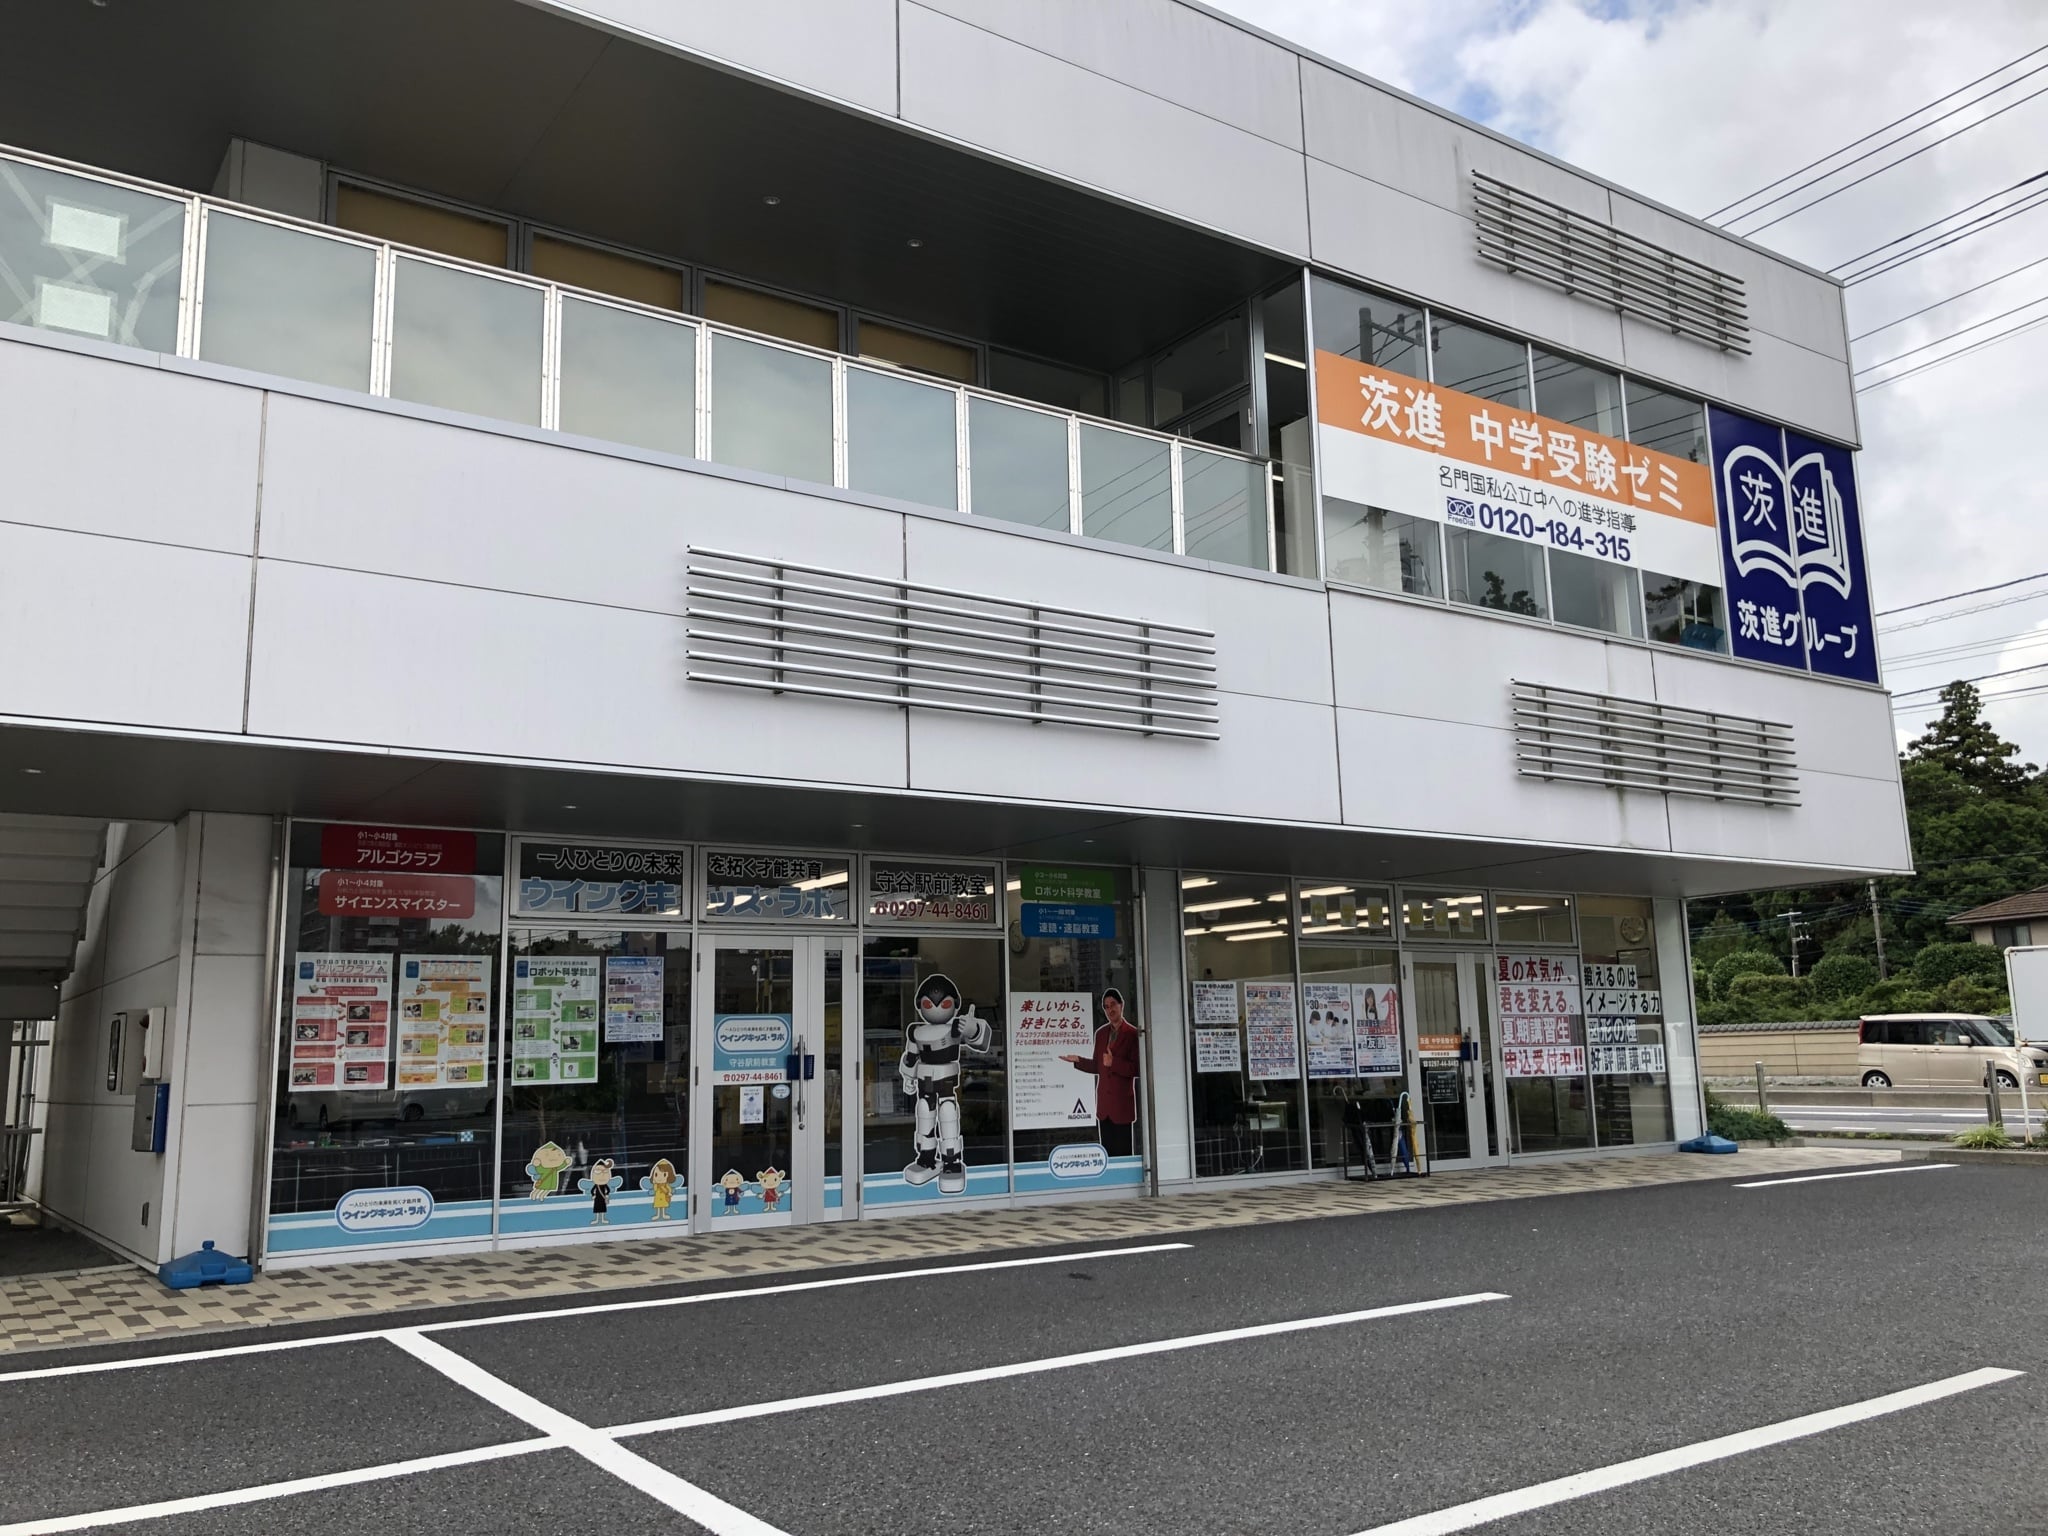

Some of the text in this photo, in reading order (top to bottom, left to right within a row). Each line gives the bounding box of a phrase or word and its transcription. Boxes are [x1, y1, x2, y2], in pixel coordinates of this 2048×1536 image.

[1359, 375, 1683, 512] 茨進 中学受験ゼミ
[1439, 465, 1637, 534] 名門国私公立中への進学指導
[1479, 502, 1632, 563] 0120-184-315
[1737, 598, 1859, 659] 茨進グループ
[357, 848, 443, 867] アルゴクラブ
[536, 848, 823, 881] 一人ひとりの未来 を拓く才能共育
[875, 870, 988, 897] 守谷駅前教室
[1035, 886, 1102, 899] ロボット科学教室
[335, 895, 461, 911] サイエンスマイスター
[1497, 956, 1574, 984] 夏の本気が、
[1584, 965, 1637, 987] 鍛えるのは
[1500, 987, 1575, 1013] 君を変える。
[1586, 992, 1660, 1014] イメージする力
[1502, 1016, 1571, 1045] 夏期講習生
